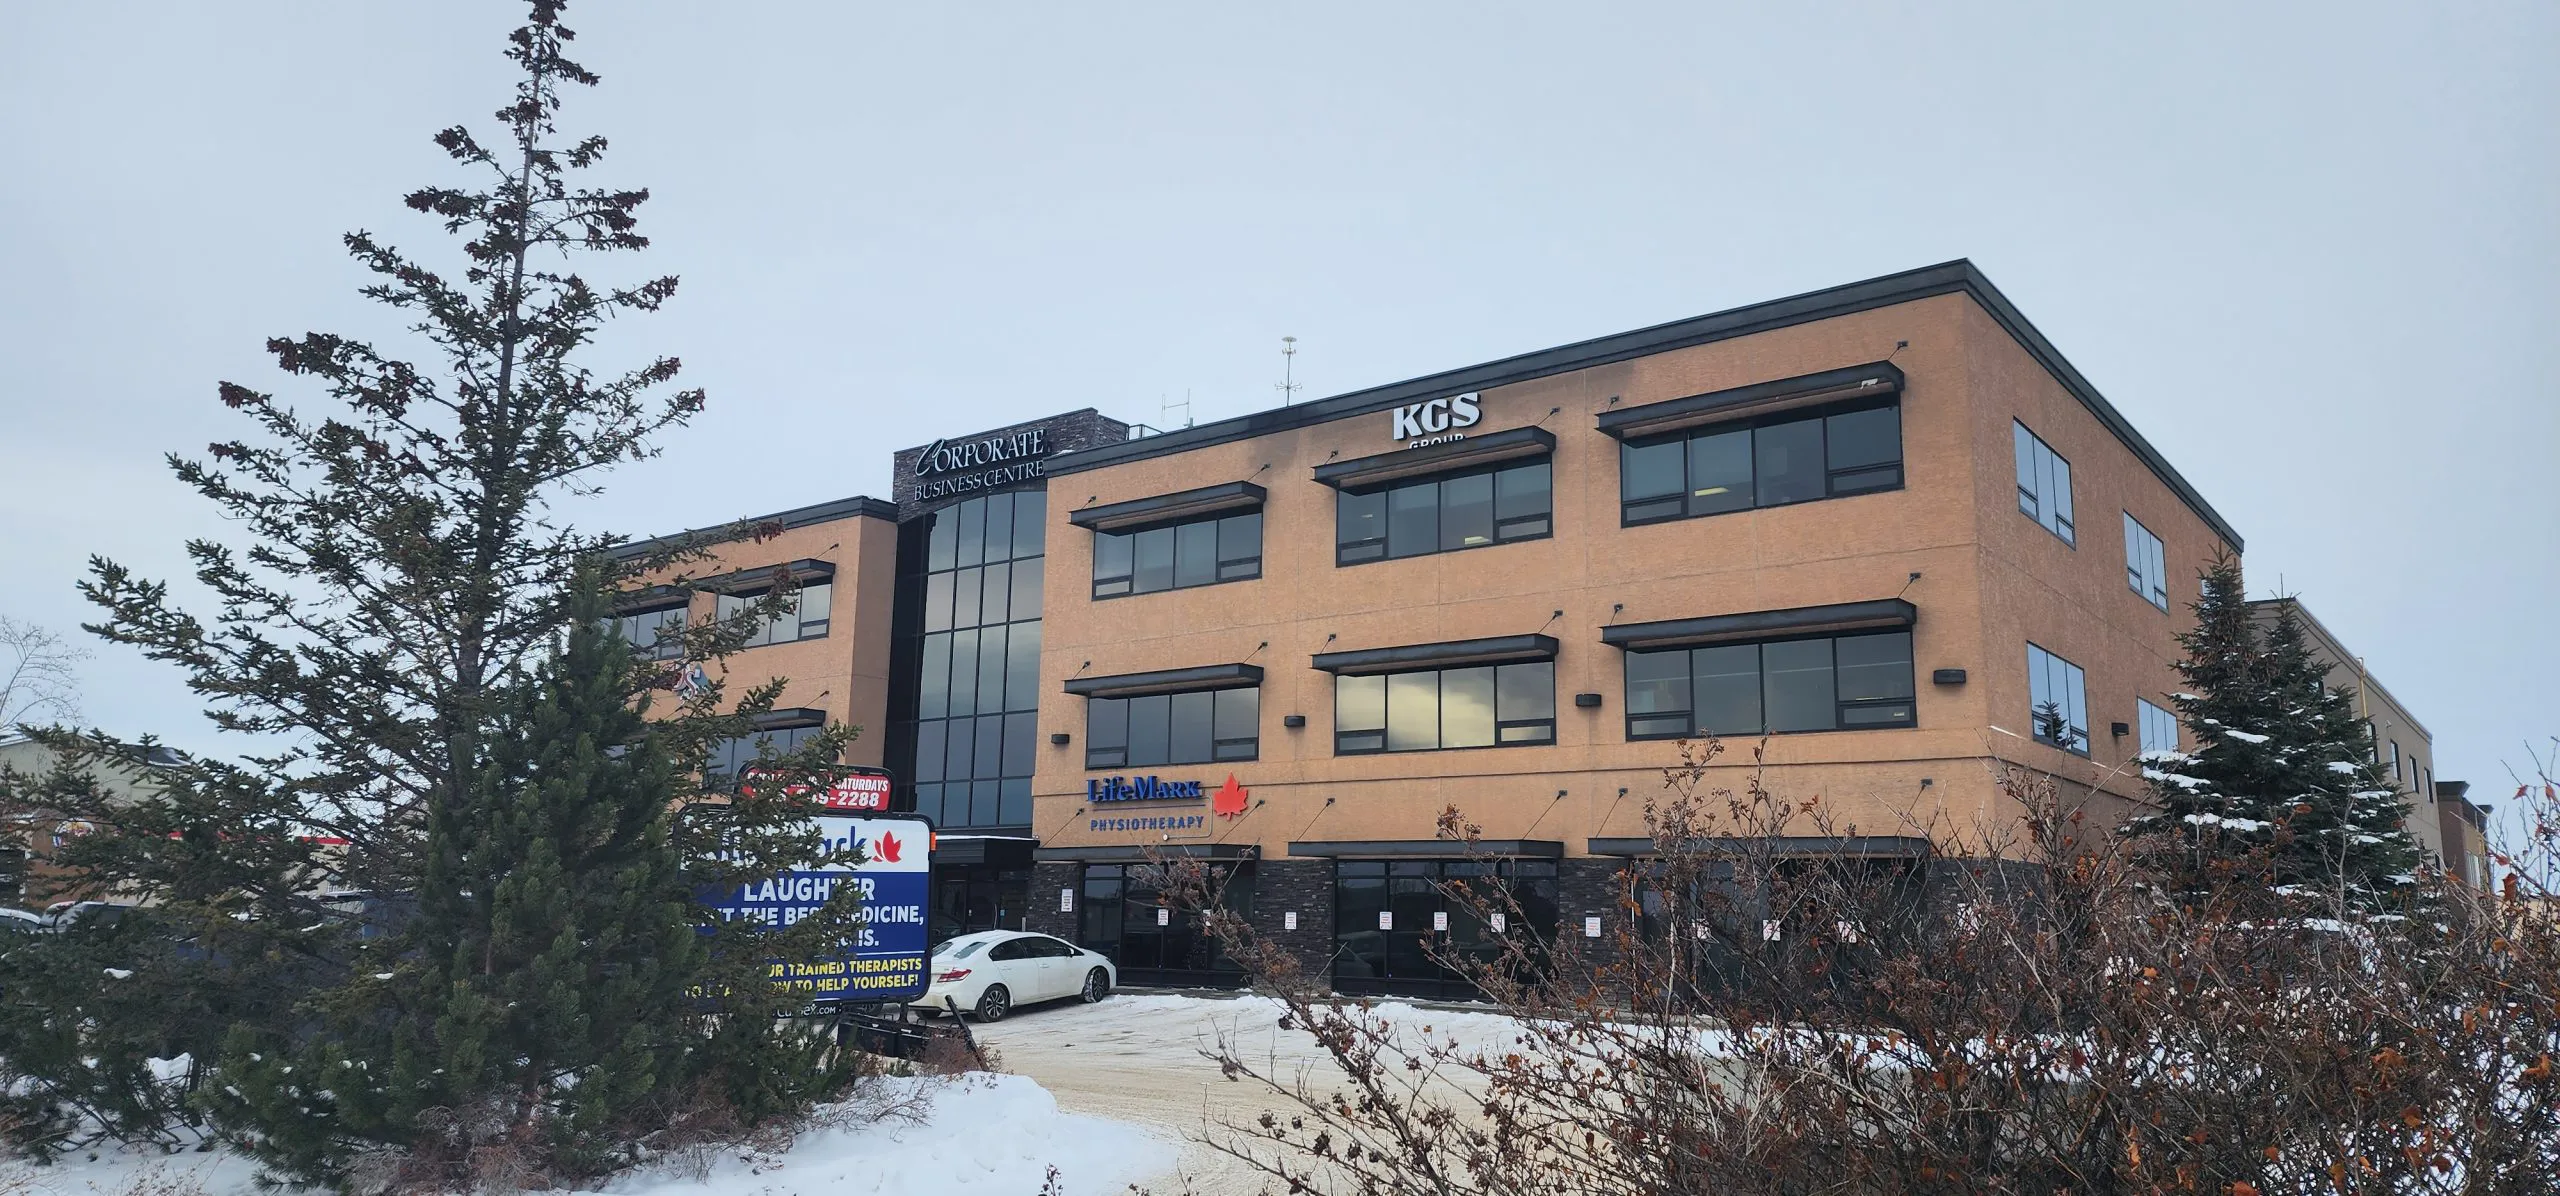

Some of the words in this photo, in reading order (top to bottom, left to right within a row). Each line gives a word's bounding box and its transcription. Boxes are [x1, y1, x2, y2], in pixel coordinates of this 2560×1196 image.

[1393, 392, 1480, 440] KGS
[915, 429, 1045, 477] CORPORATE
[914, 473, 982, 501] BUSINESS
[984, 460, 1045, 487] CENTRE
[1090, 816, 1204, 832] PHYSIOTHERAPY
[740, 907, 778, 926] THE
[836, 904, 924, 926] DICINE,
[788, 960, 846, 978] TRAINED
[849, 957, 922, 973] THERAPISTS
[817, 977, 849, 992] HELP
[853, 973, 919, 990] YOURSELF!
